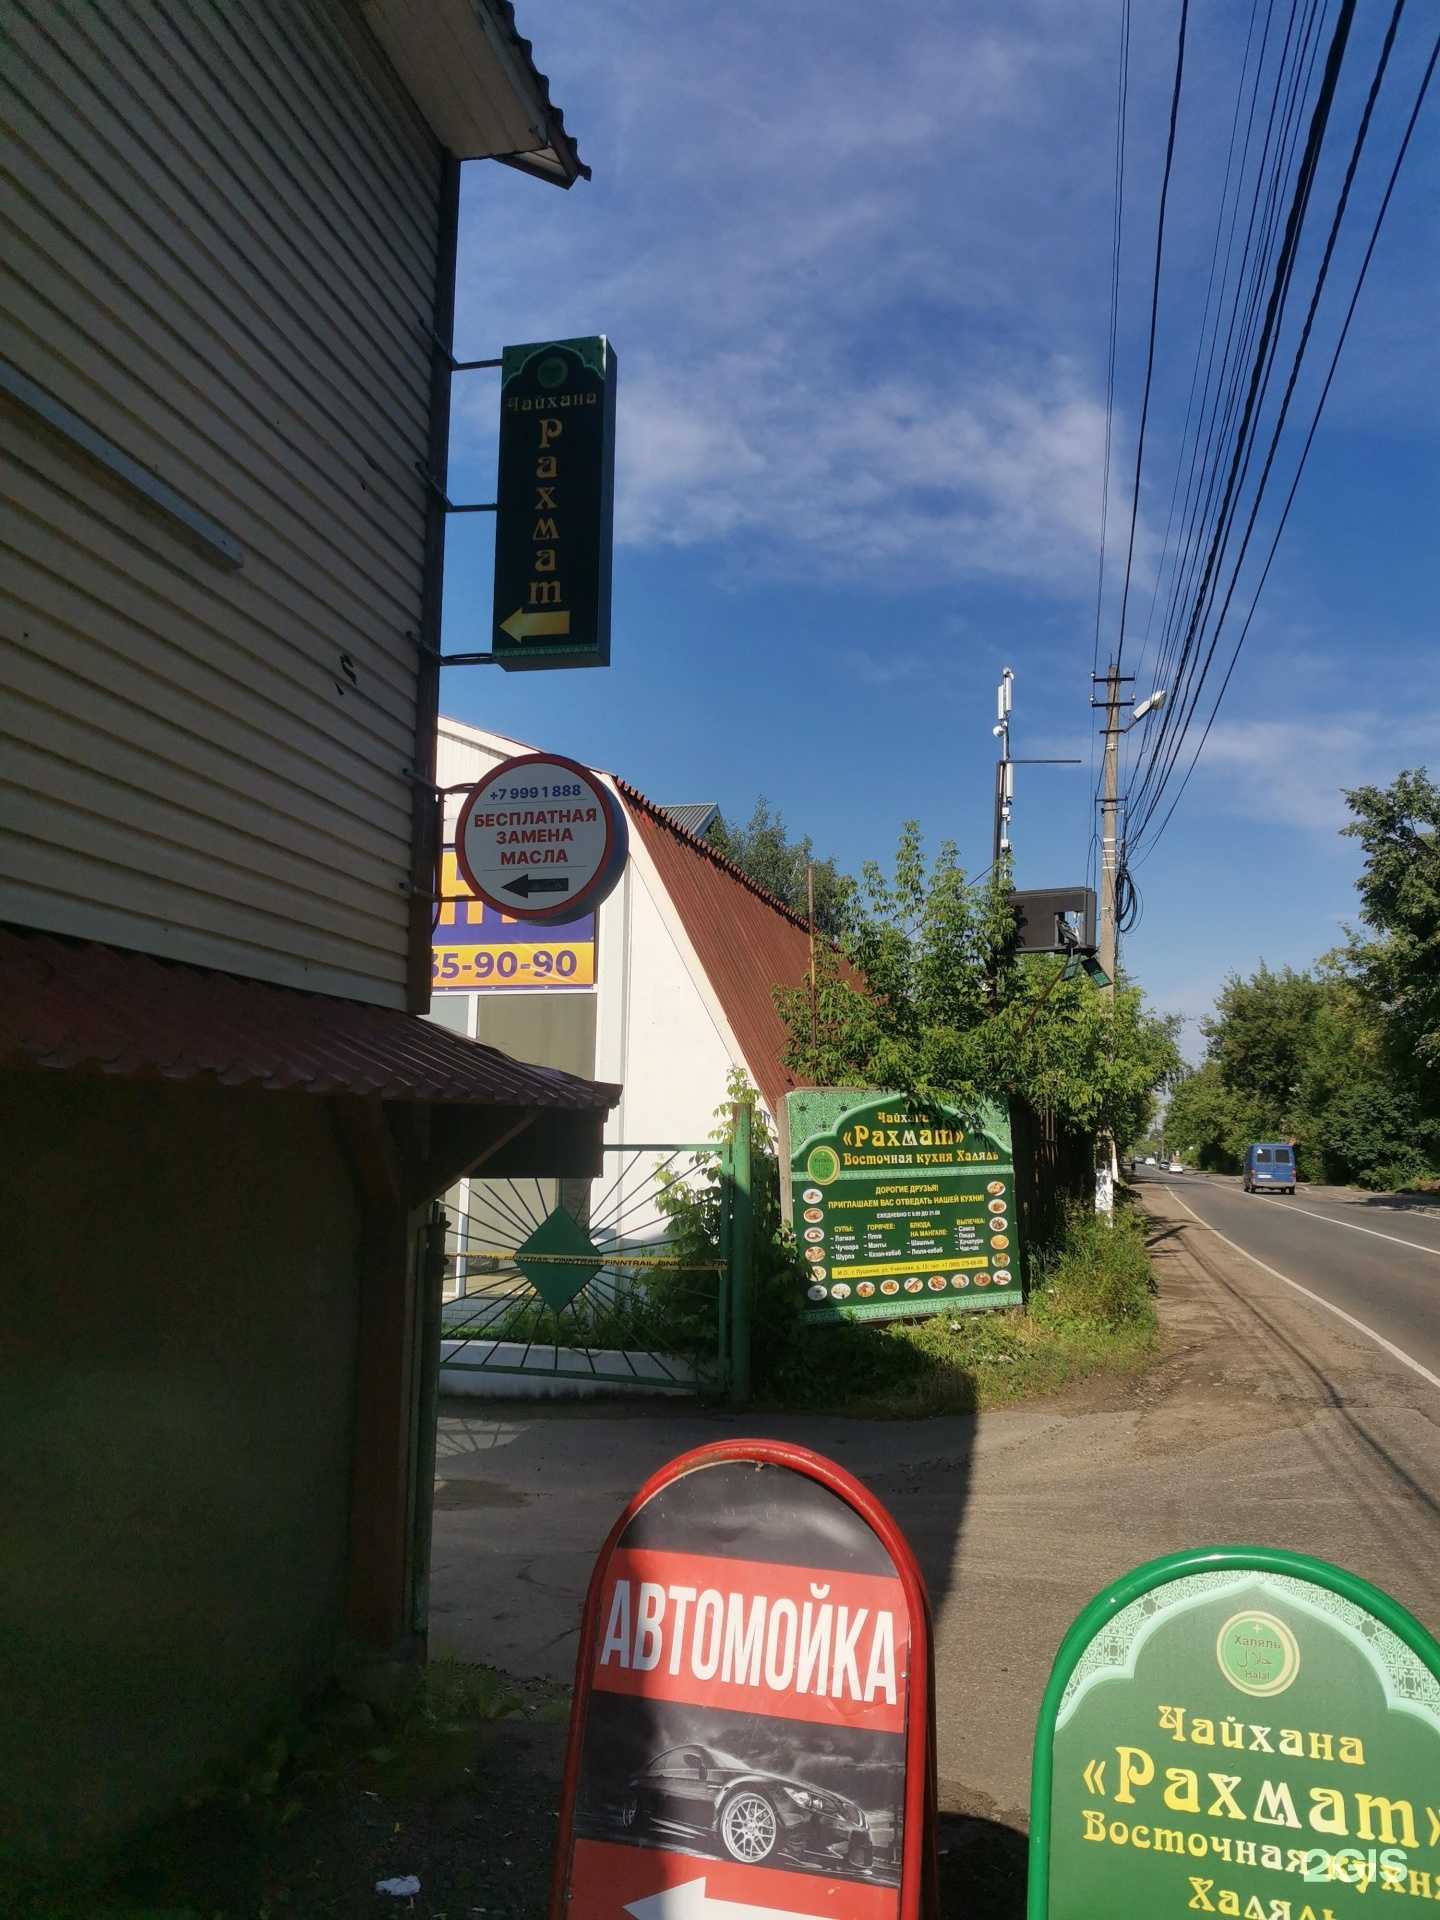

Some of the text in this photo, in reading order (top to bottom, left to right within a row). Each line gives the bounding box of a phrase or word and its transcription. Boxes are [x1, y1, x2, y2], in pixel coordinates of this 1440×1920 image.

[507, 392, 597, 411] Чайхана
[490, 788, 507, 800] +7
[474, 808, 597, 828] БЕСПЛАТНАЯ
[496, 828, 573, 844] ЗАМЕНА
[500, 849, 568, 865] МАСЛА
[843, 1125, 965, 1148] «Рахмат»
[843, 1150, 999, 1166] Восточная кухня Халяль
[875, 1184, 939, 1196] ДОРОГИЕ ДРУЗЬЯ!
[828, 1199, 879, 1209] ПРИГЛАШАЕМ
[880, 1198, 895, 1207] ВАС
[896, 1197, 932, 1207] ОТВЕДАТЬ
[933, 1195, 960, 1205] НАШЕЙ
[600, 1579, 898, 1706] АВТОМОЙКА
[1157, 1705, 1366, 1766] Чайхана
[1081, 1810, 1310, 1877] Восточная
